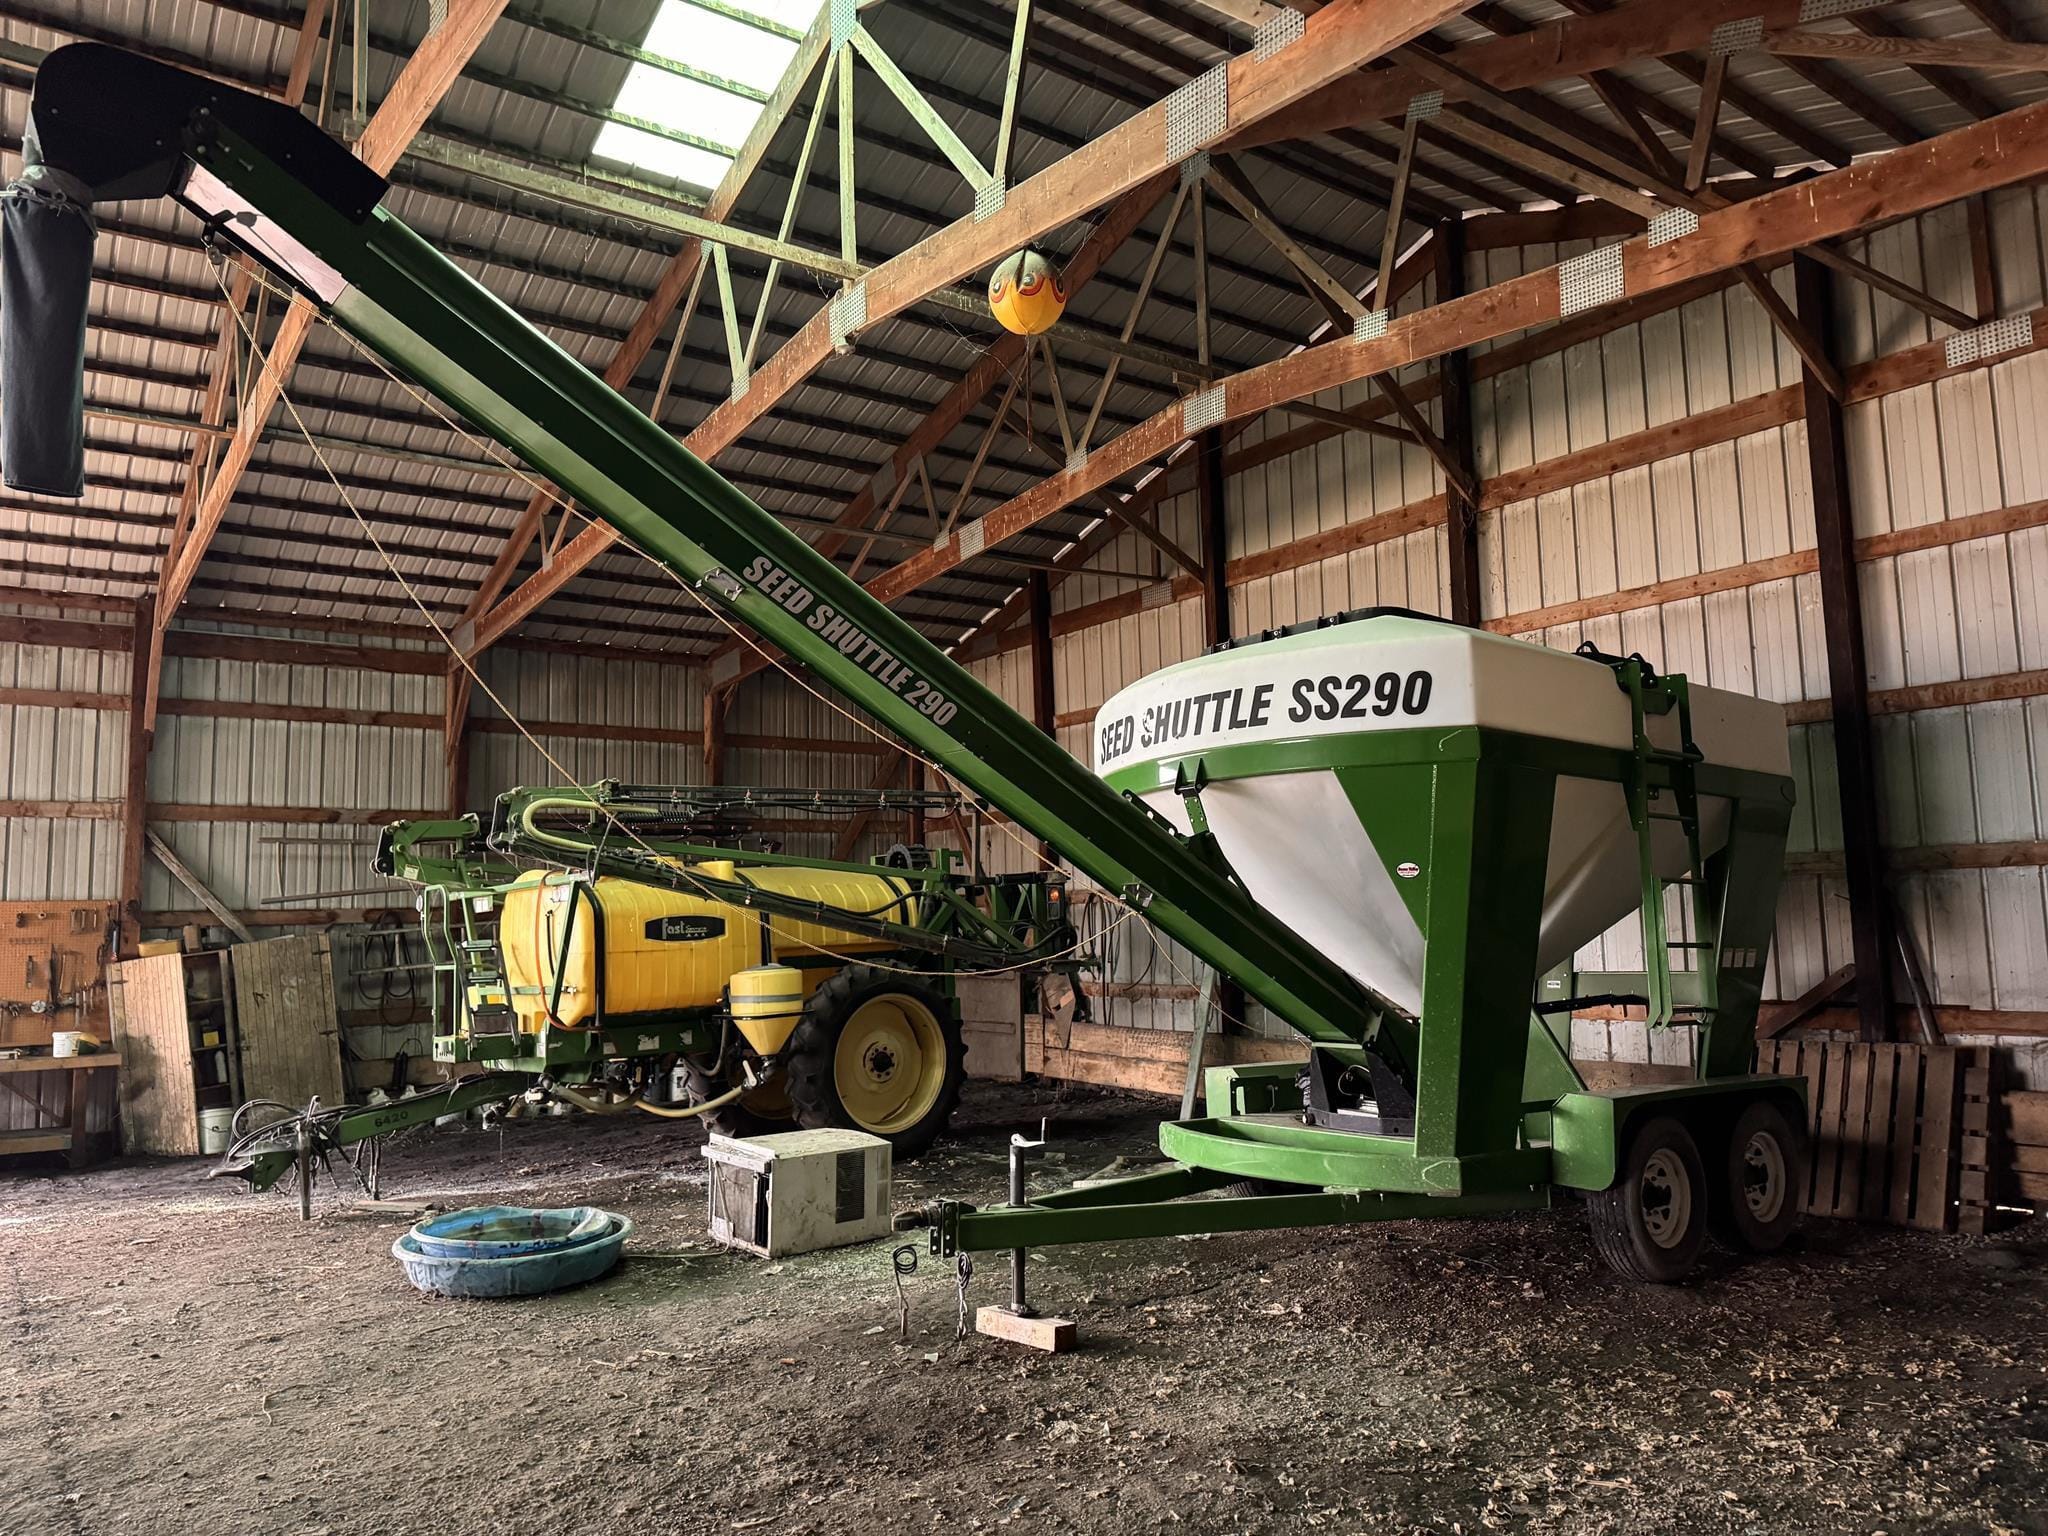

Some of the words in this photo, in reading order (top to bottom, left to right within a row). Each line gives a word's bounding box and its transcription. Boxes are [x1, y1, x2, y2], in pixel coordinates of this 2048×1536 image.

[743, 556, 814, 614] SEED
[806, 604, 915, 692] SHUTTLE
[904, 680, 958, 726] 290
[1101, 716, 1135, 765] SEED
[1141, 683, 1274, 748] SHUTTLE
[1288, 670, 1433, 723] SS290
[375, 1110, 409, 1127] 6420
